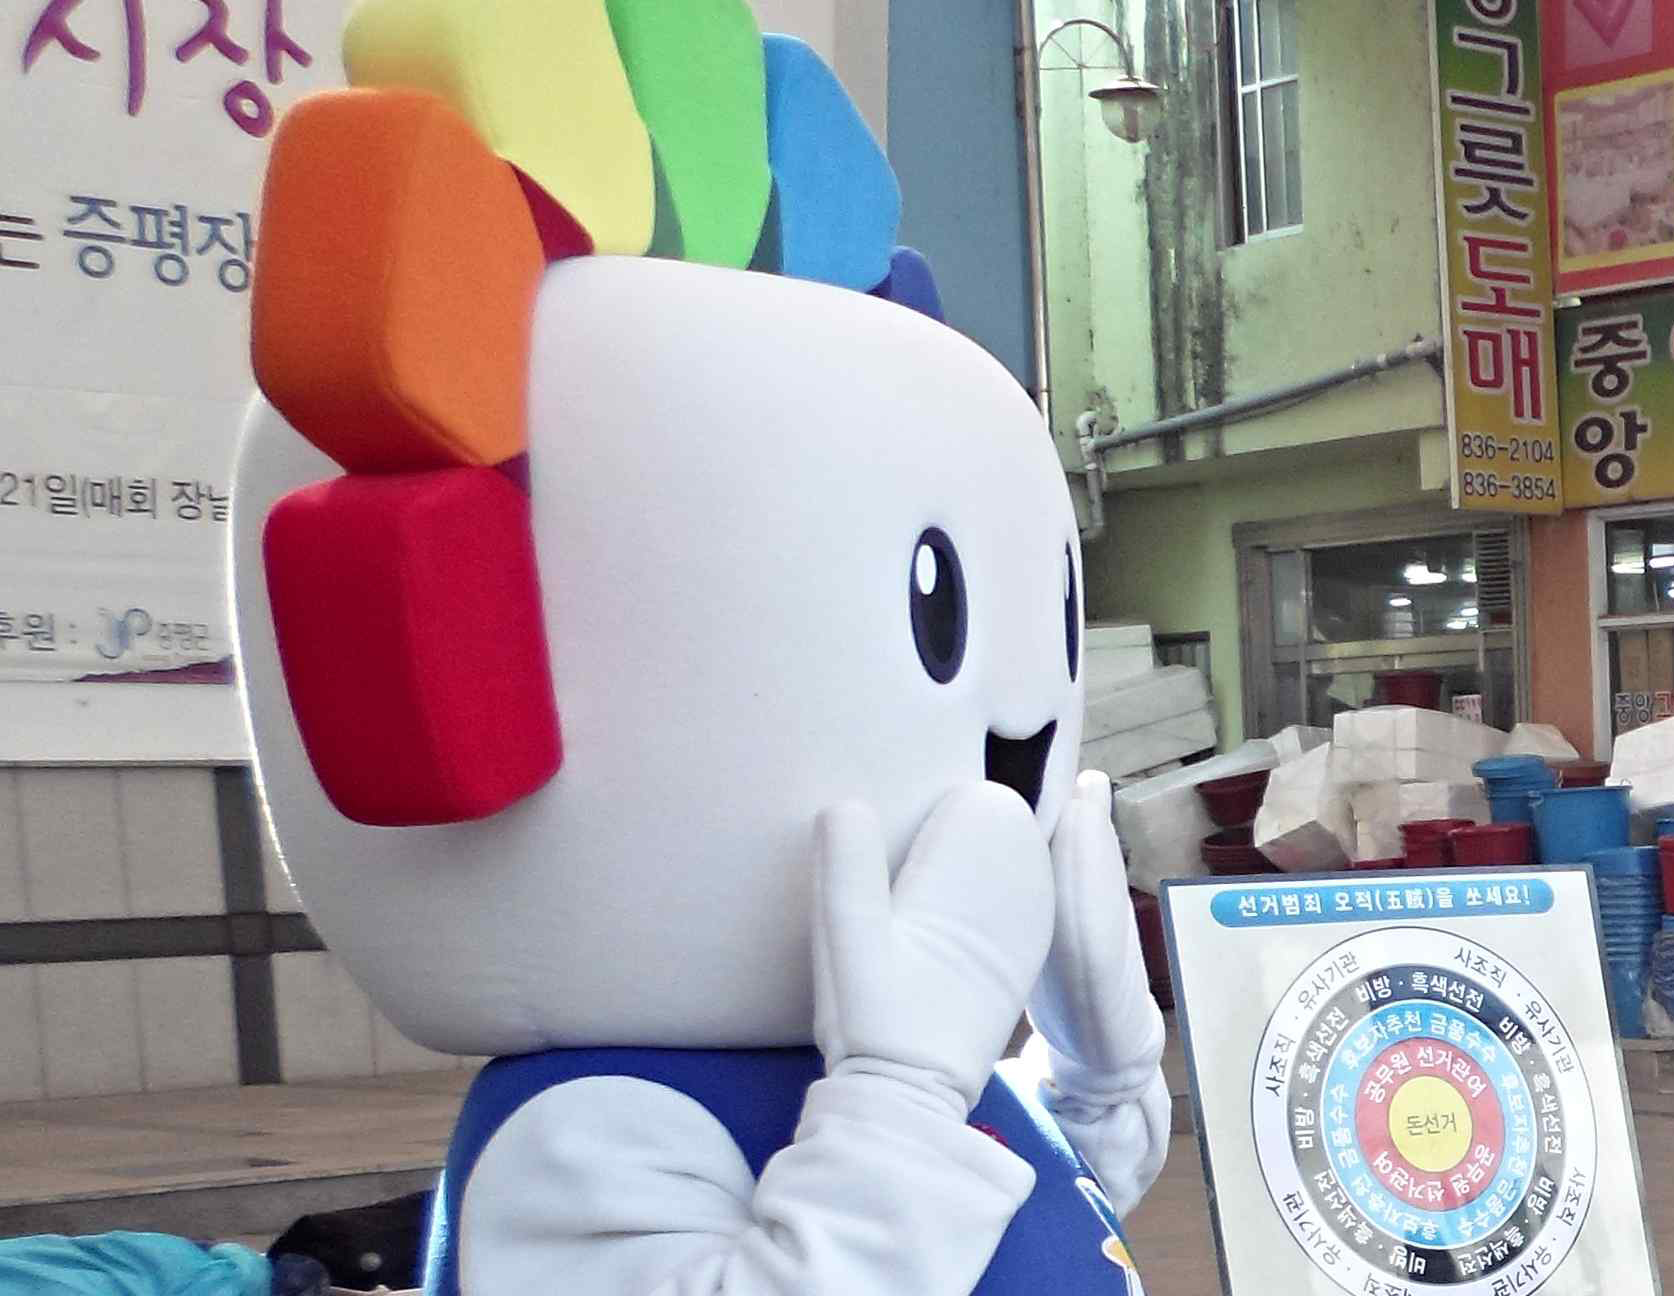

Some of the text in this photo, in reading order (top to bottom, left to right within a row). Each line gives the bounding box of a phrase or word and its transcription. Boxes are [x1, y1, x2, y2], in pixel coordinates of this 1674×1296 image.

[1571, 316, 1650, 490] 중앙
[1461, 432, 1555, 464] 836-2104
[1462, 471, 1557, 500] 836-3854
[1237, 891, 1323, 917] 선거범죄
[1465, 885, 1531, 906] 쏘세요!
[1355, 971, 1484, 1013] 비방 흑색선전
[1453, 946, 1575, 1075] 사조직 유사기관
[1265, 951, 1360, 1097] 사조직 유사기관
[1499, 1016, 1532, 1055] 비방
[1363, 1045, 1487, 1104] 공무원 선거관여
[1294, 1106, 1316, 1151] 비방
[1406, 1113, 1458, 1136] 돈선거
[1372, 1143, 1497, 1202] 공무원 선거관여
[1555, 1167, 1588, 1226] 사조직
[1281, 1190, 1343, 1266] 유사기관
[1456, 1176, 1555, 1277] 비방 흑색선전
[1388, 1245, 1427, 1276] 비방
